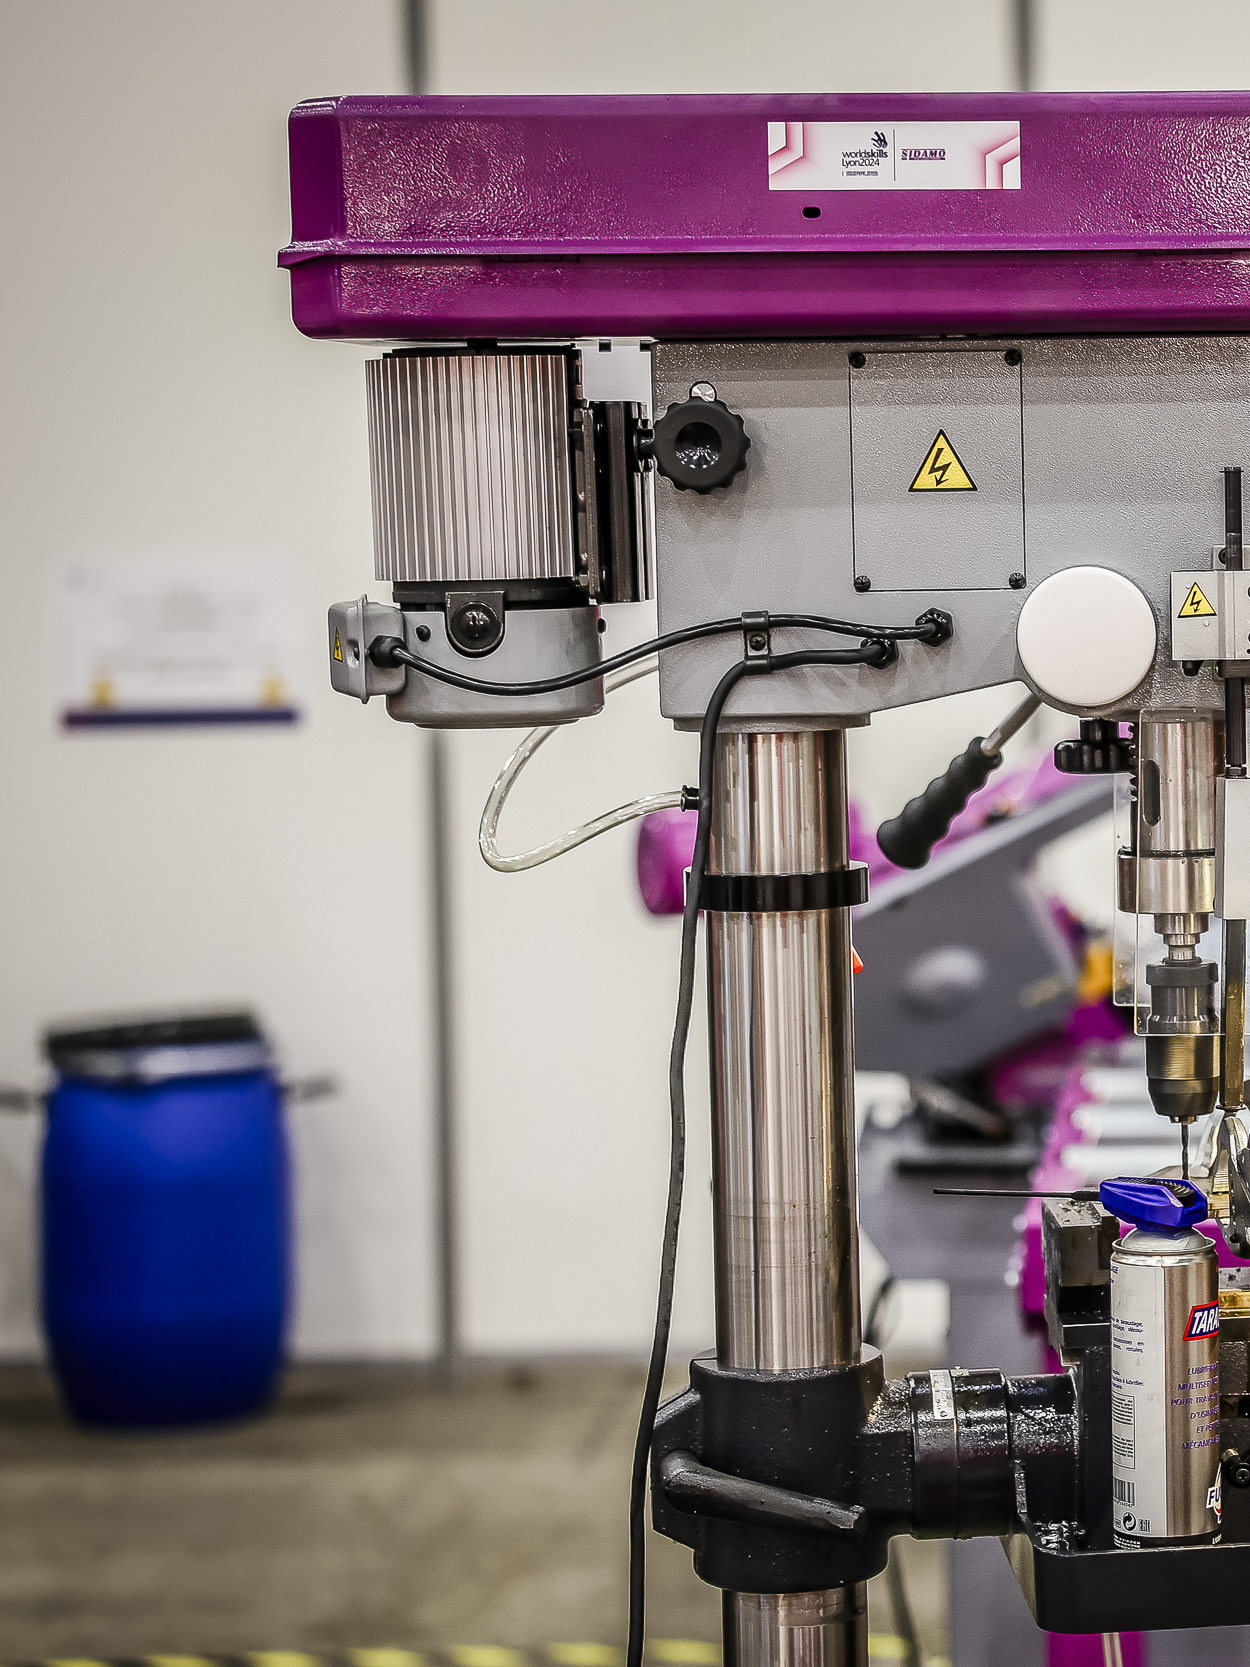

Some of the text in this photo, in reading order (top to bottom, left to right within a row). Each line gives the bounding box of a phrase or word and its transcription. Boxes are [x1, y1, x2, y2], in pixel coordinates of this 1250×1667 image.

[842, 149, 888, 158] worldskills
[901, 149, 946, 160] SIDAMO
[1191, 1307, 1220, 1335] TARA
[1171, 1397, 1193, 1406] POUR
[1197, 1425, 1204, 1433] ET
